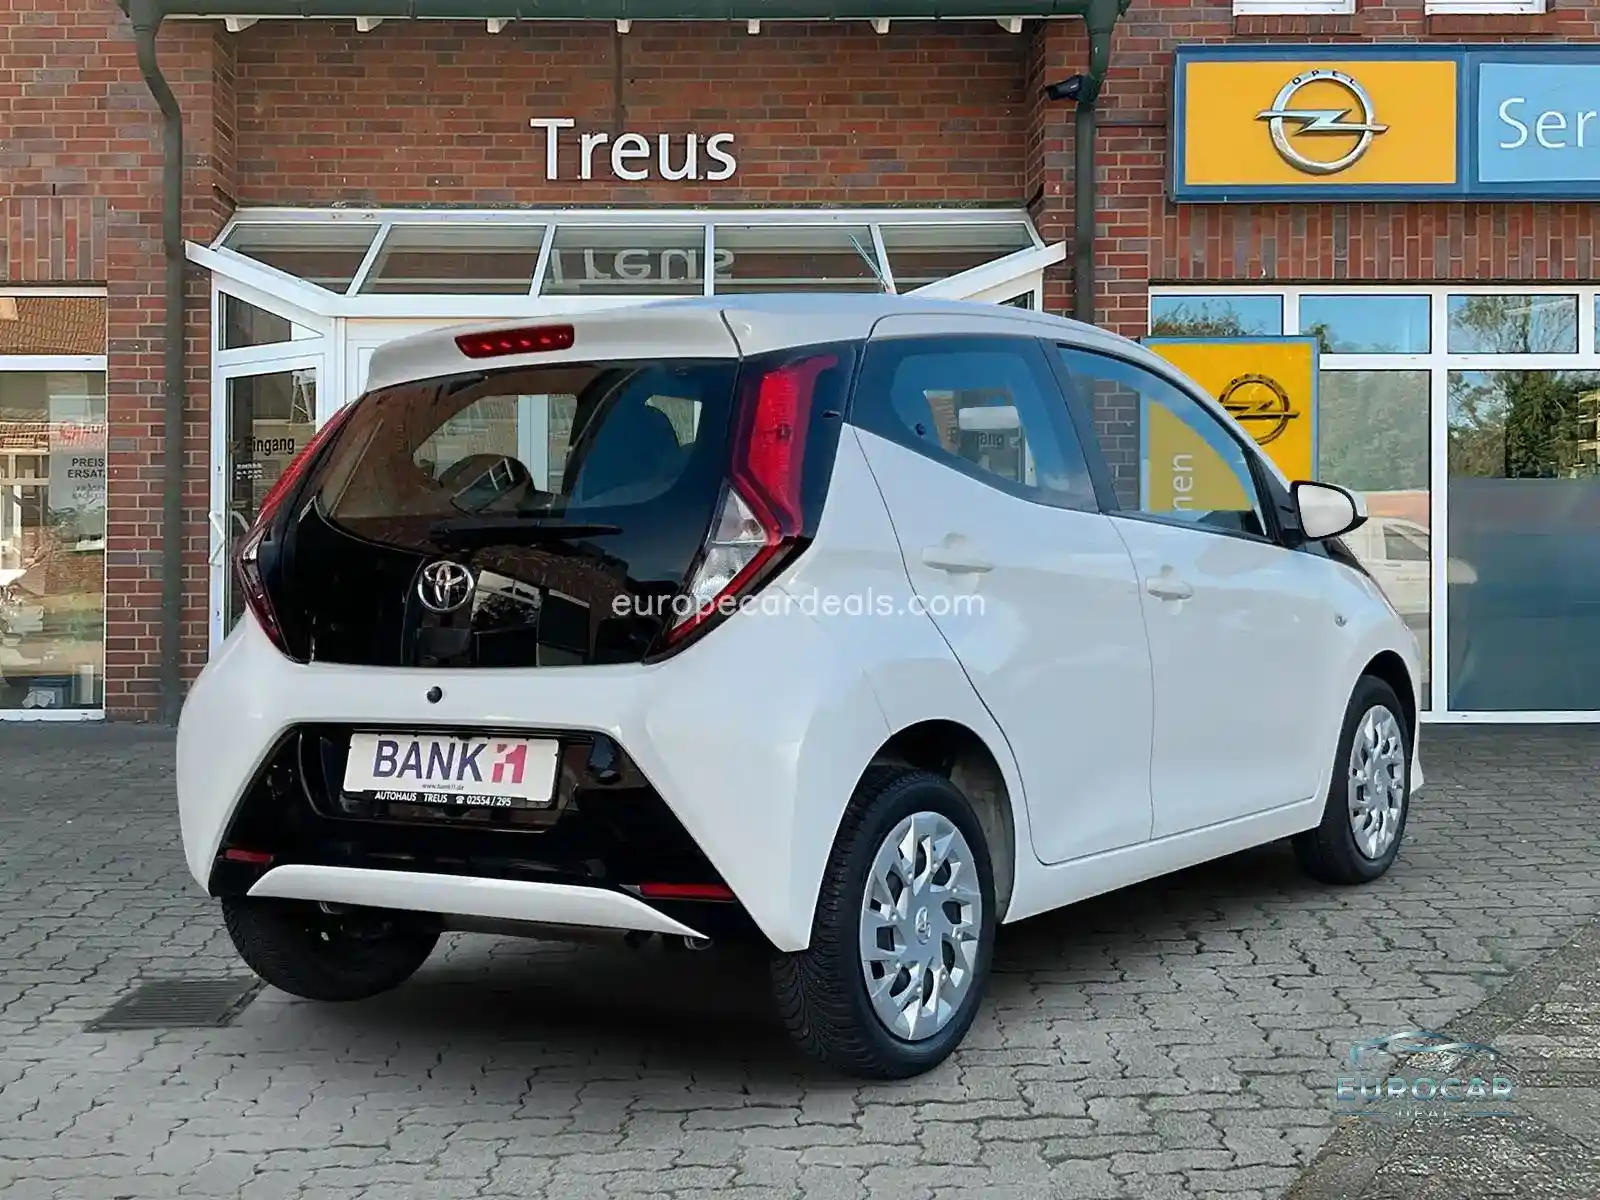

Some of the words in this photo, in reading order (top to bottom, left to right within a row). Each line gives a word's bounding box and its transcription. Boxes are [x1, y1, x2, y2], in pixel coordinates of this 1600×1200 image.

[1291, 69, 1357, 86] OPEL
[1498, 97, 1597, 149] Ser
[529, 117, 738, 181] Treus
[374, 790, 418, 803] AUTOHAUS
[423, 792, 448, 804] TREUS
